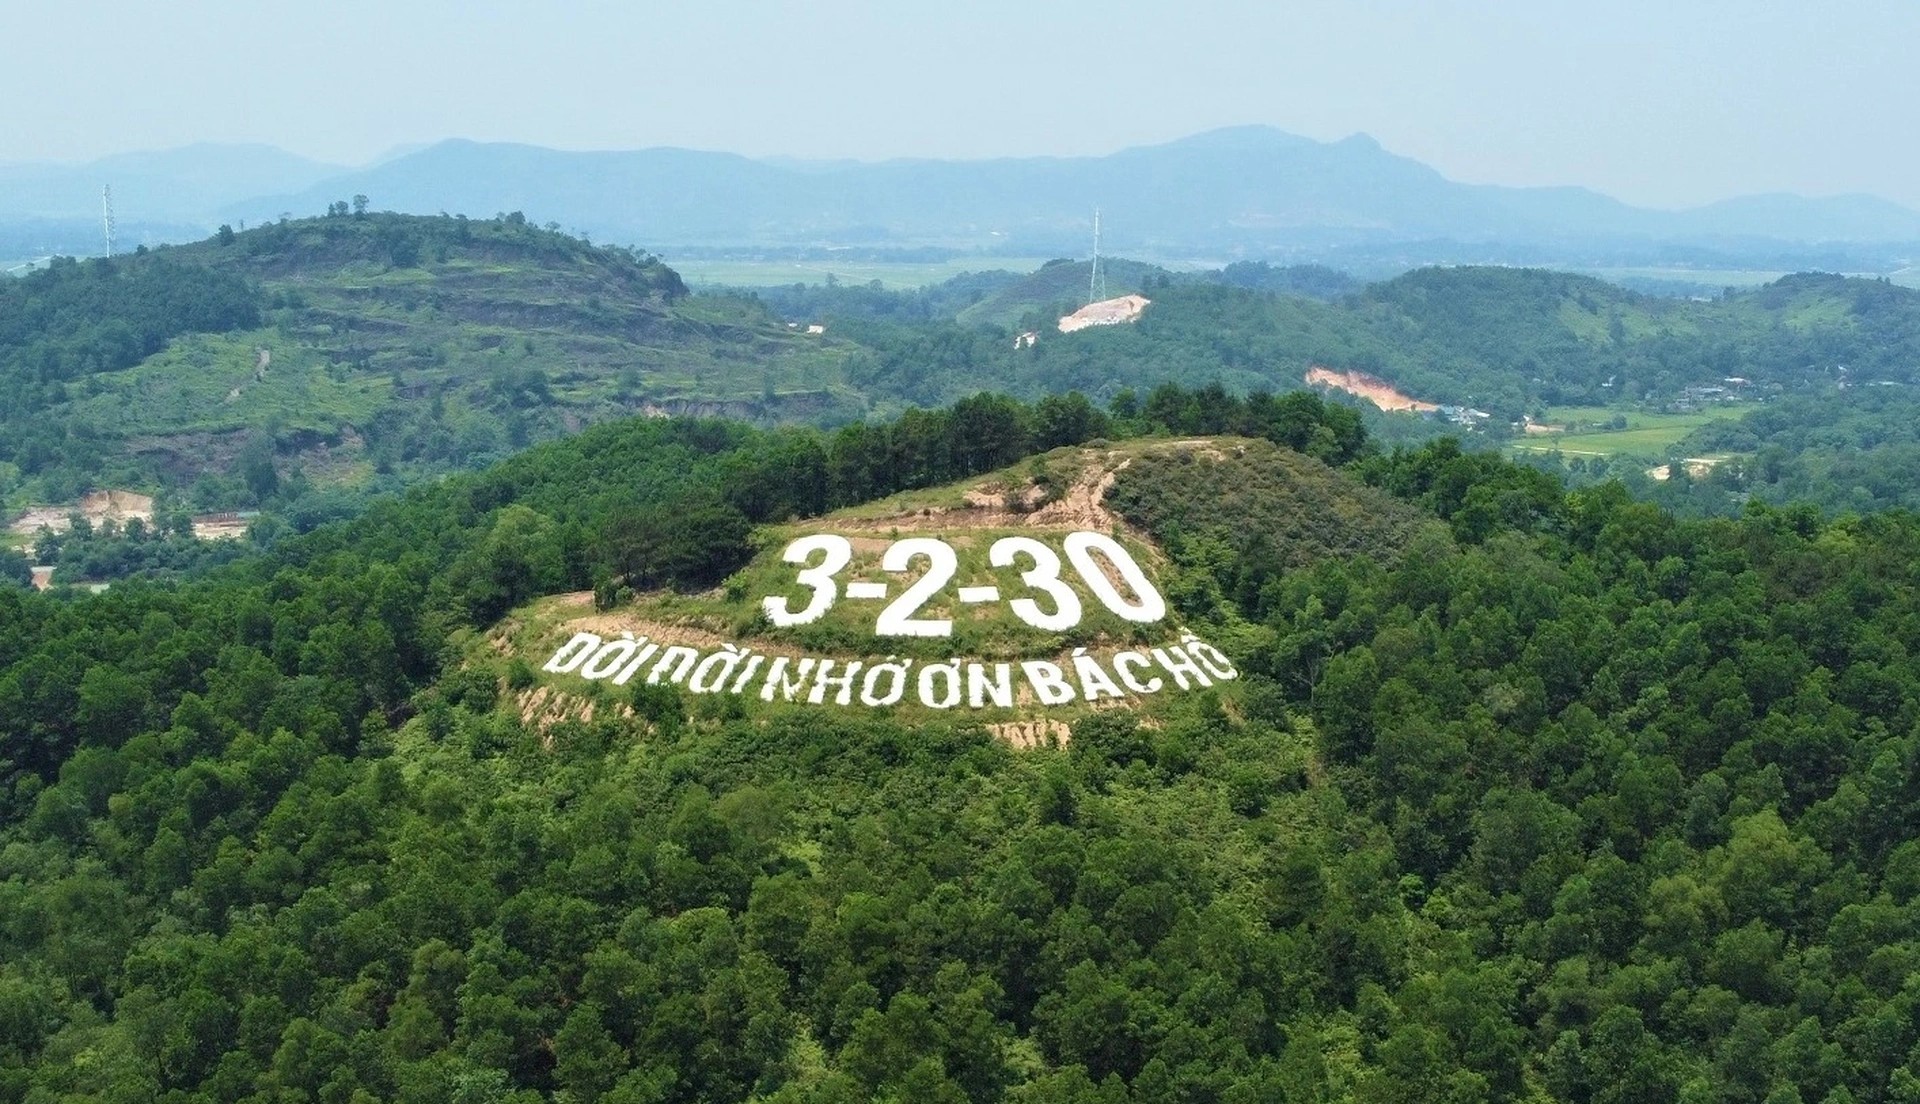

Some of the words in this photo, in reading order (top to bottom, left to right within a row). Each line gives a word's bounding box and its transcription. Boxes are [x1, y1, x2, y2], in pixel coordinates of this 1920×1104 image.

[762, 531, 1167, 638] 3-2-30
[760, 655, 913, 707] NHỚ
[917, 657, 1014, 709] ƠN
[1020, 646, 1163, 706] BÁC
[1149, 626, 1238, 691] HỒ
